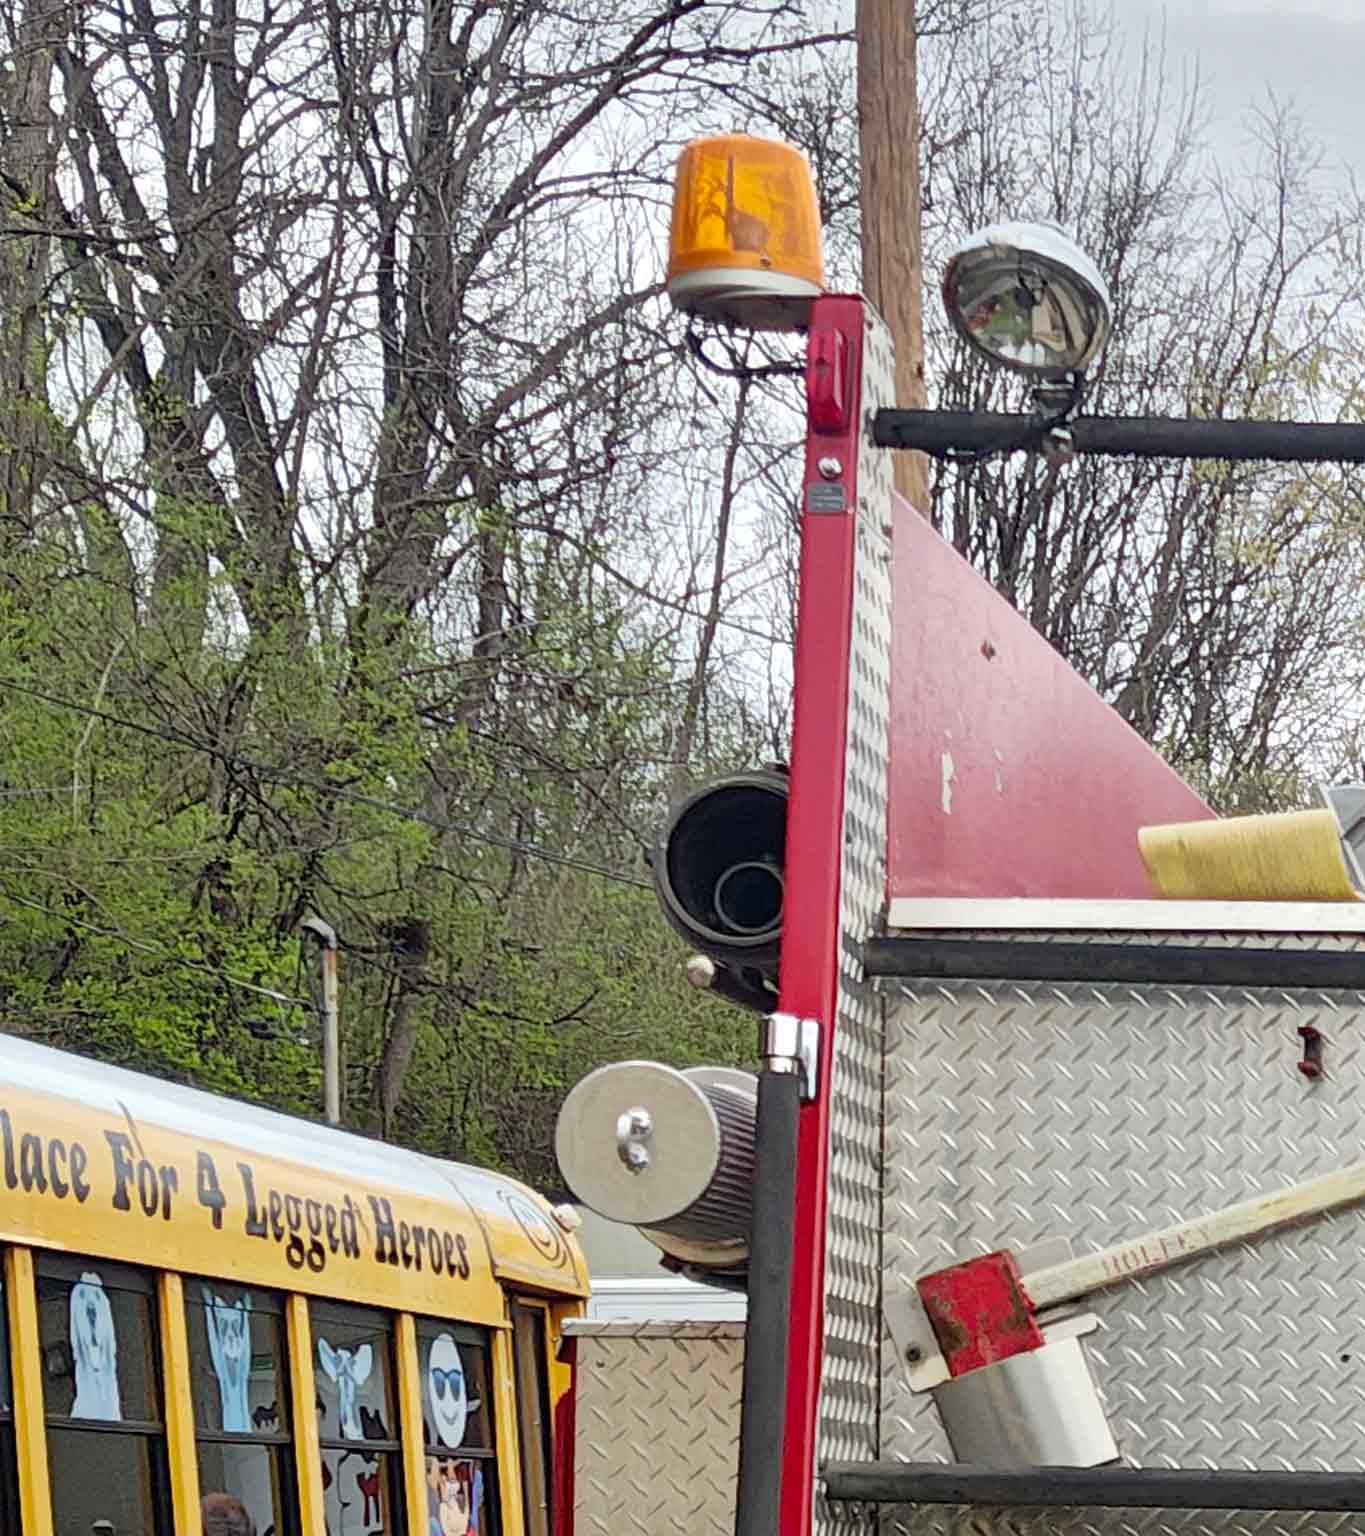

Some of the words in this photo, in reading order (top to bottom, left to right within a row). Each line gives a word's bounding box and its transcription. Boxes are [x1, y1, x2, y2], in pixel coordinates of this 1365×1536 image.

[104, 1129, 178, 1221] For
[196, 1150, 226, 1230] 4
[237, 1162, 360, 1273] Legged
[367, 1195, 469, 1280] Heroes
